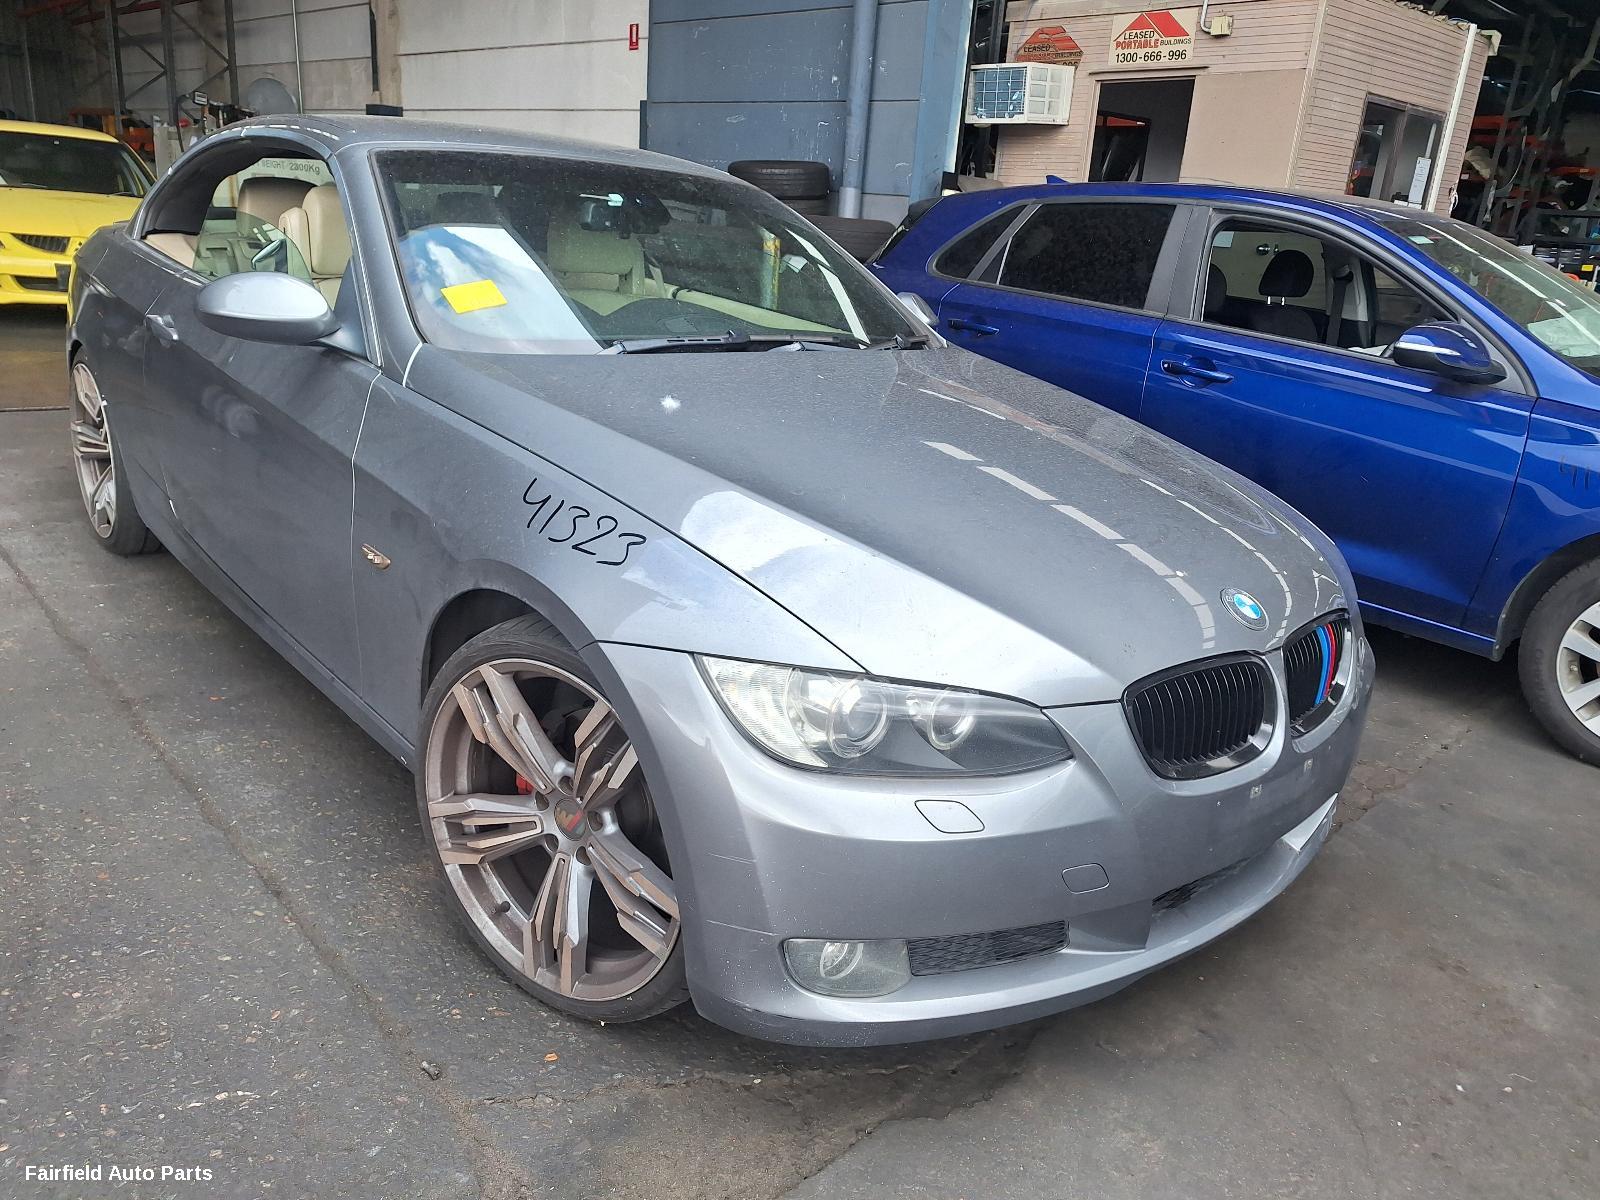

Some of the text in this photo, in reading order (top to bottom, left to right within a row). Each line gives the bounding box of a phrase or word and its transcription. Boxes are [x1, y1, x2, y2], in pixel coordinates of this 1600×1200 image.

[1123, 31, 1155, 40] LEASED
[1023, 44, 1051, 53] LEASED
[1115, 38, 1192, 50] PORTABLE BUILDINGS
[1115, 50, 1187, 63] 1300-666-996
[523, 477, 647, 566] 41323
